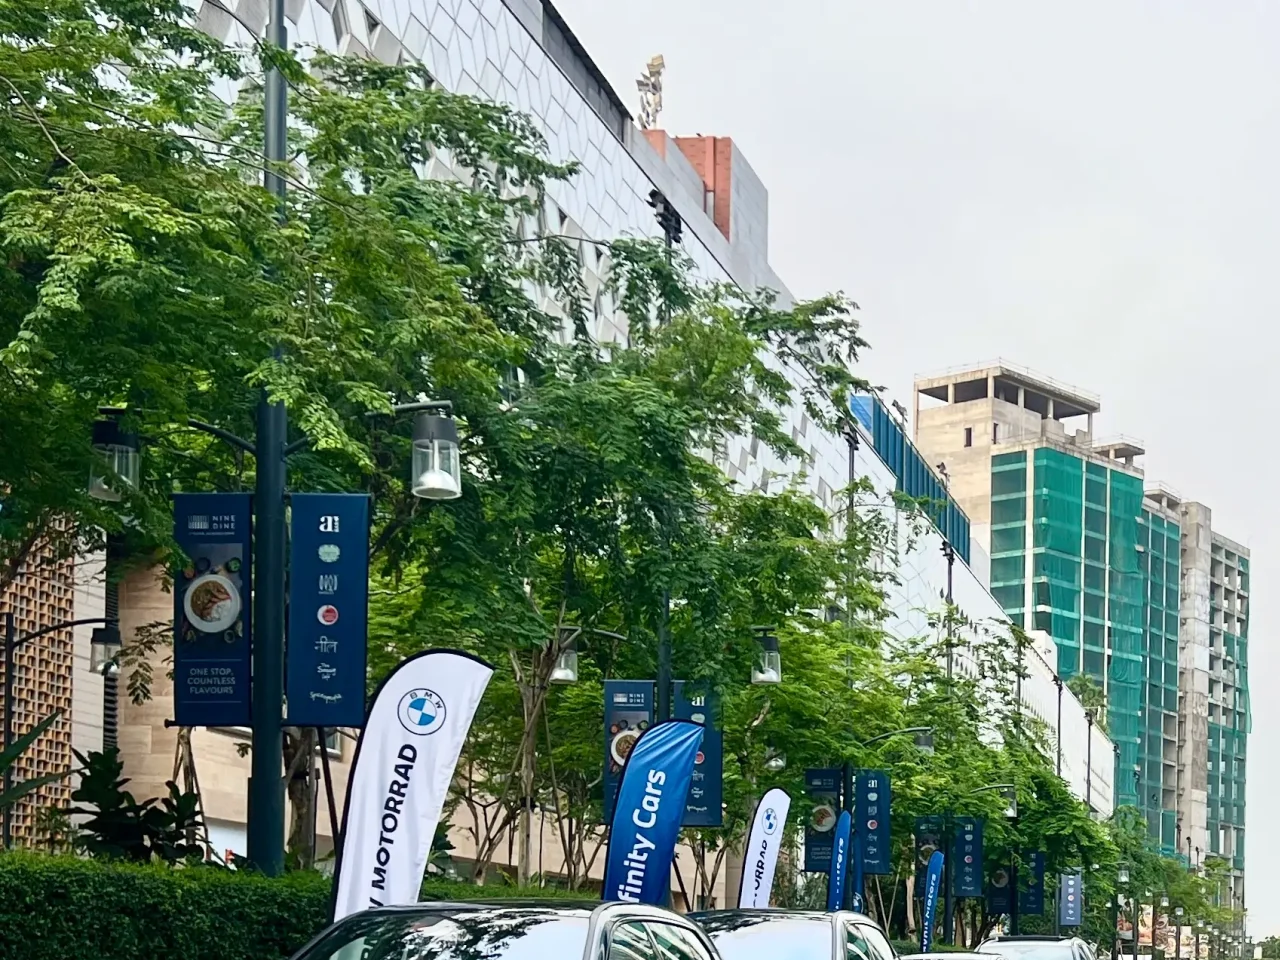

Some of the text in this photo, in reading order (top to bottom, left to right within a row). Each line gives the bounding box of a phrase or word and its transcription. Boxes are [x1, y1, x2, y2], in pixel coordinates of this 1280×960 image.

[190, 667, 209, 676] ONE
[187, 676, 236, 685] COUNTLESS
[189, 686, 234, 694] FLAVOURS
[410, 691, 443, 709] BMW
[371, 743, 418, 891] MOTORRAD
[617, 769, 667, 903] finity Cars
